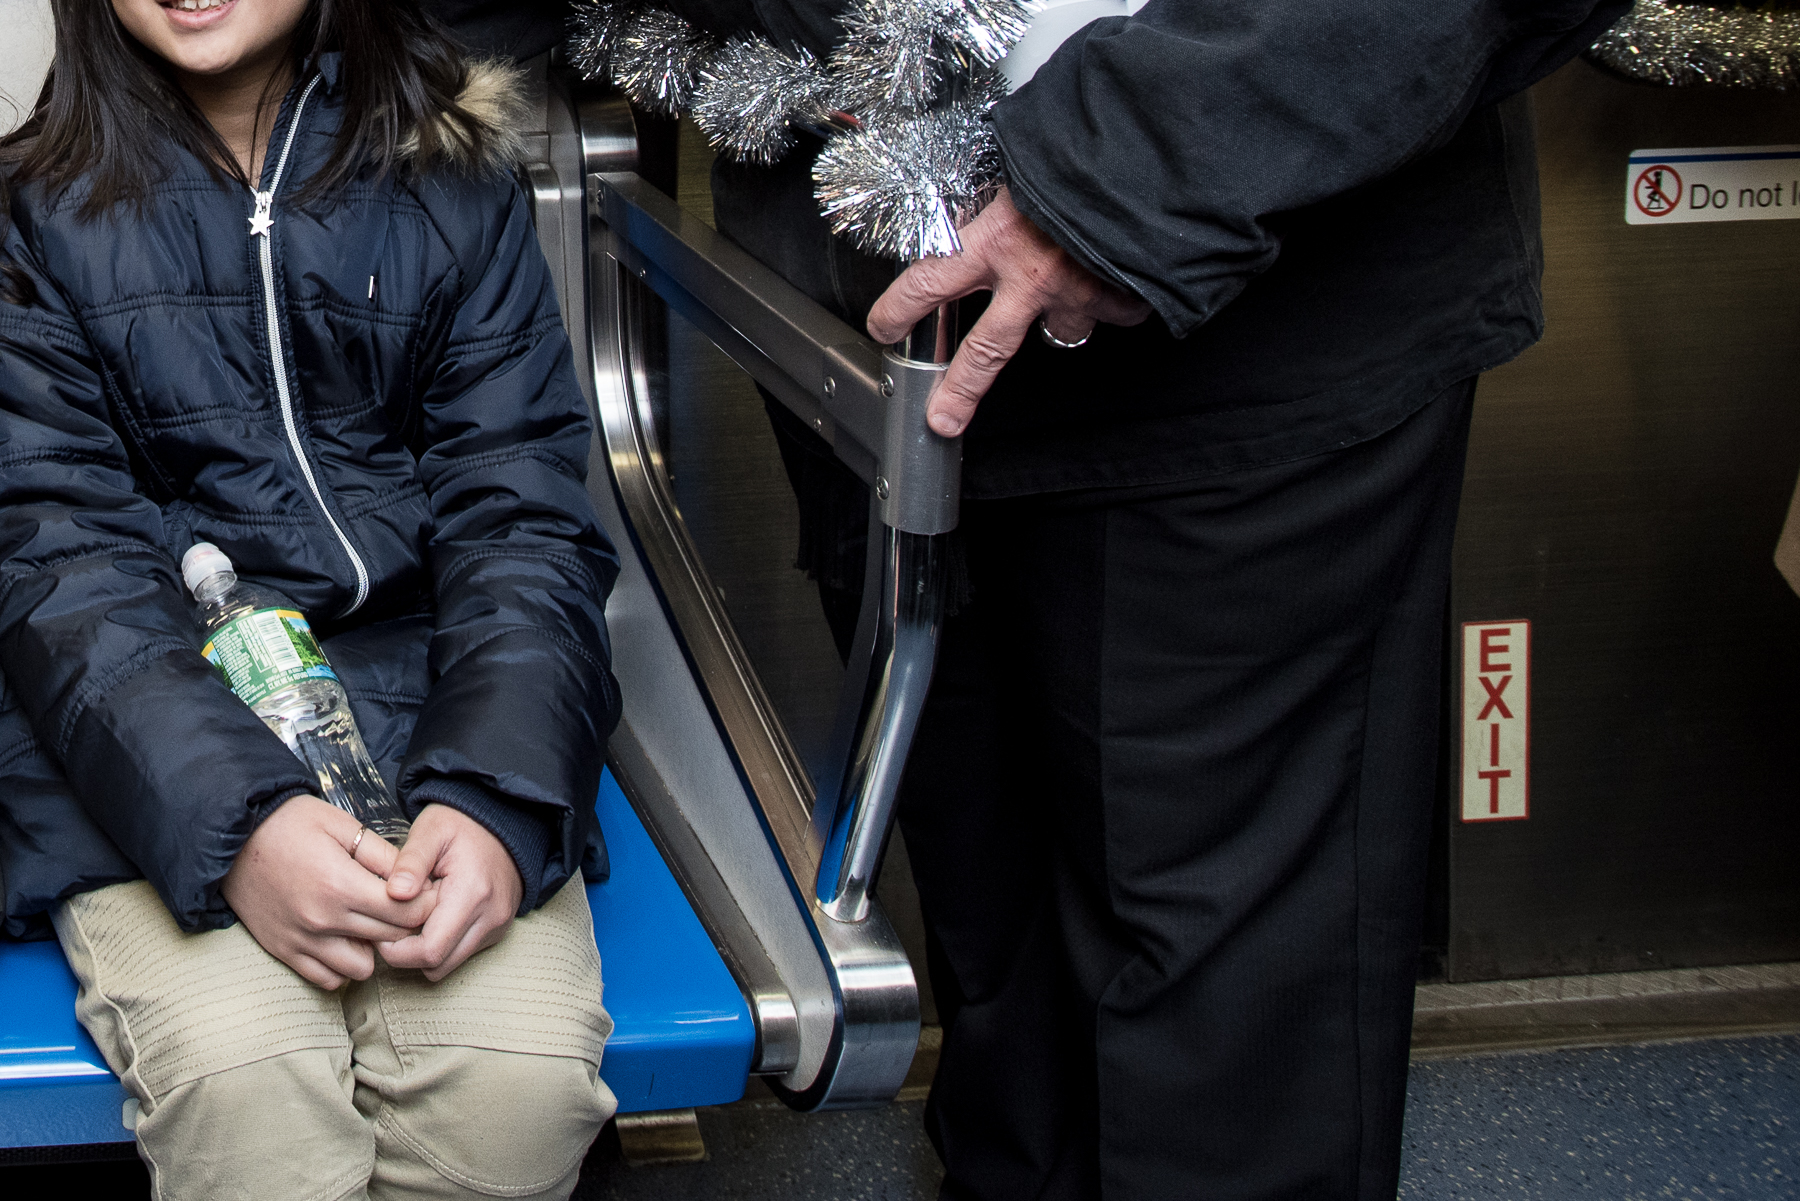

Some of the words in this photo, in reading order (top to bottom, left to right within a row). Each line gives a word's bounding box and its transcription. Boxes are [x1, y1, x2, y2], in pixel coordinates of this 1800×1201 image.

[1690, 184, 1728, 209] Do
[1739, 183, 1782, 207] not
[1792, 181, 1800, 205] l
[1477, 628, 1514, 814] EXIT
